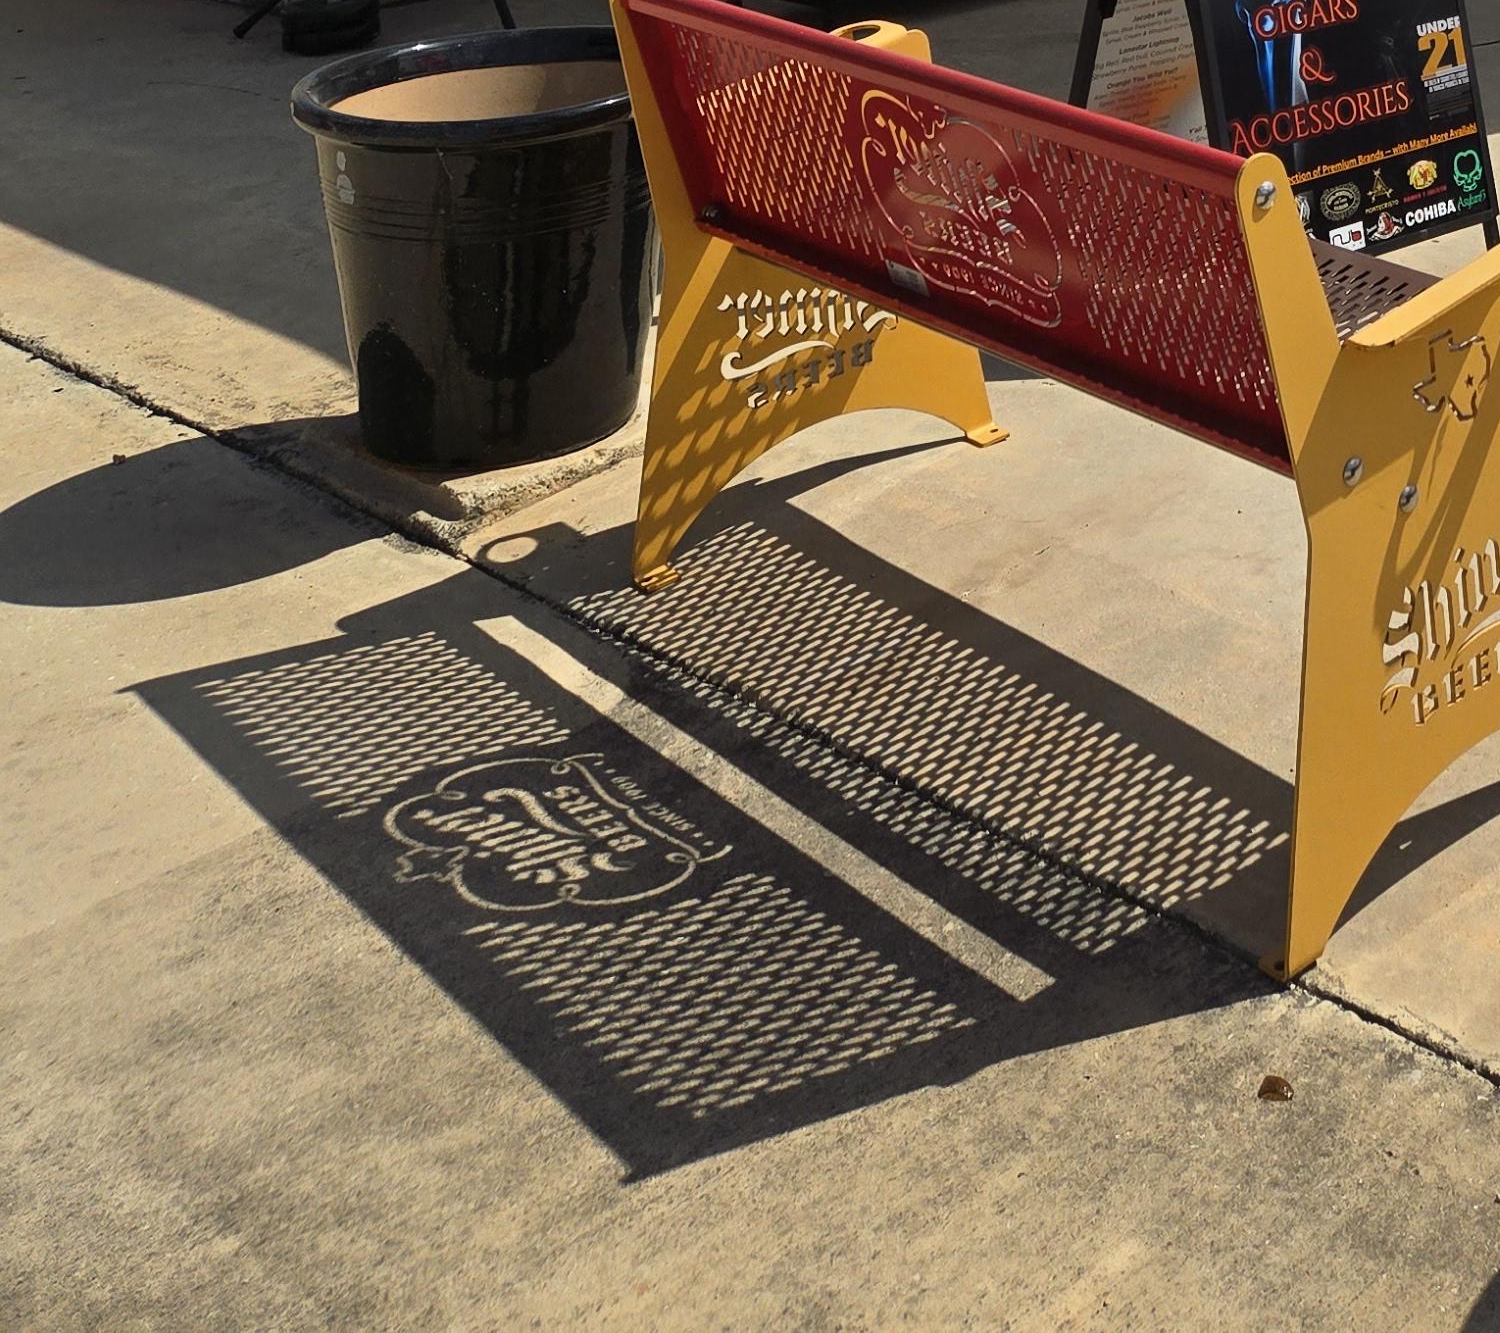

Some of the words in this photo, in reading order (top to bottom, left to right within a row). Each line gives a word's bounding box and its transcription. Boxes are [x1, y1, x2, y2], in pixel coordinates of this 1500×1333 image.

[1301, 47, 1336, 83] &
[1417, 27, 1467, 78] 21
[1231, 80, 1410, 156] ACCESSORIES
[1322, 157, 1357, 176] Premium
[1357, 148, 1385, 167] Brands
[1392, 140, 1409, 155] with
[1409, 136, 1429, 151] Many
[1430, 131, 1449, 144] More
[1405, 198, 1457, 227] COHIBA
